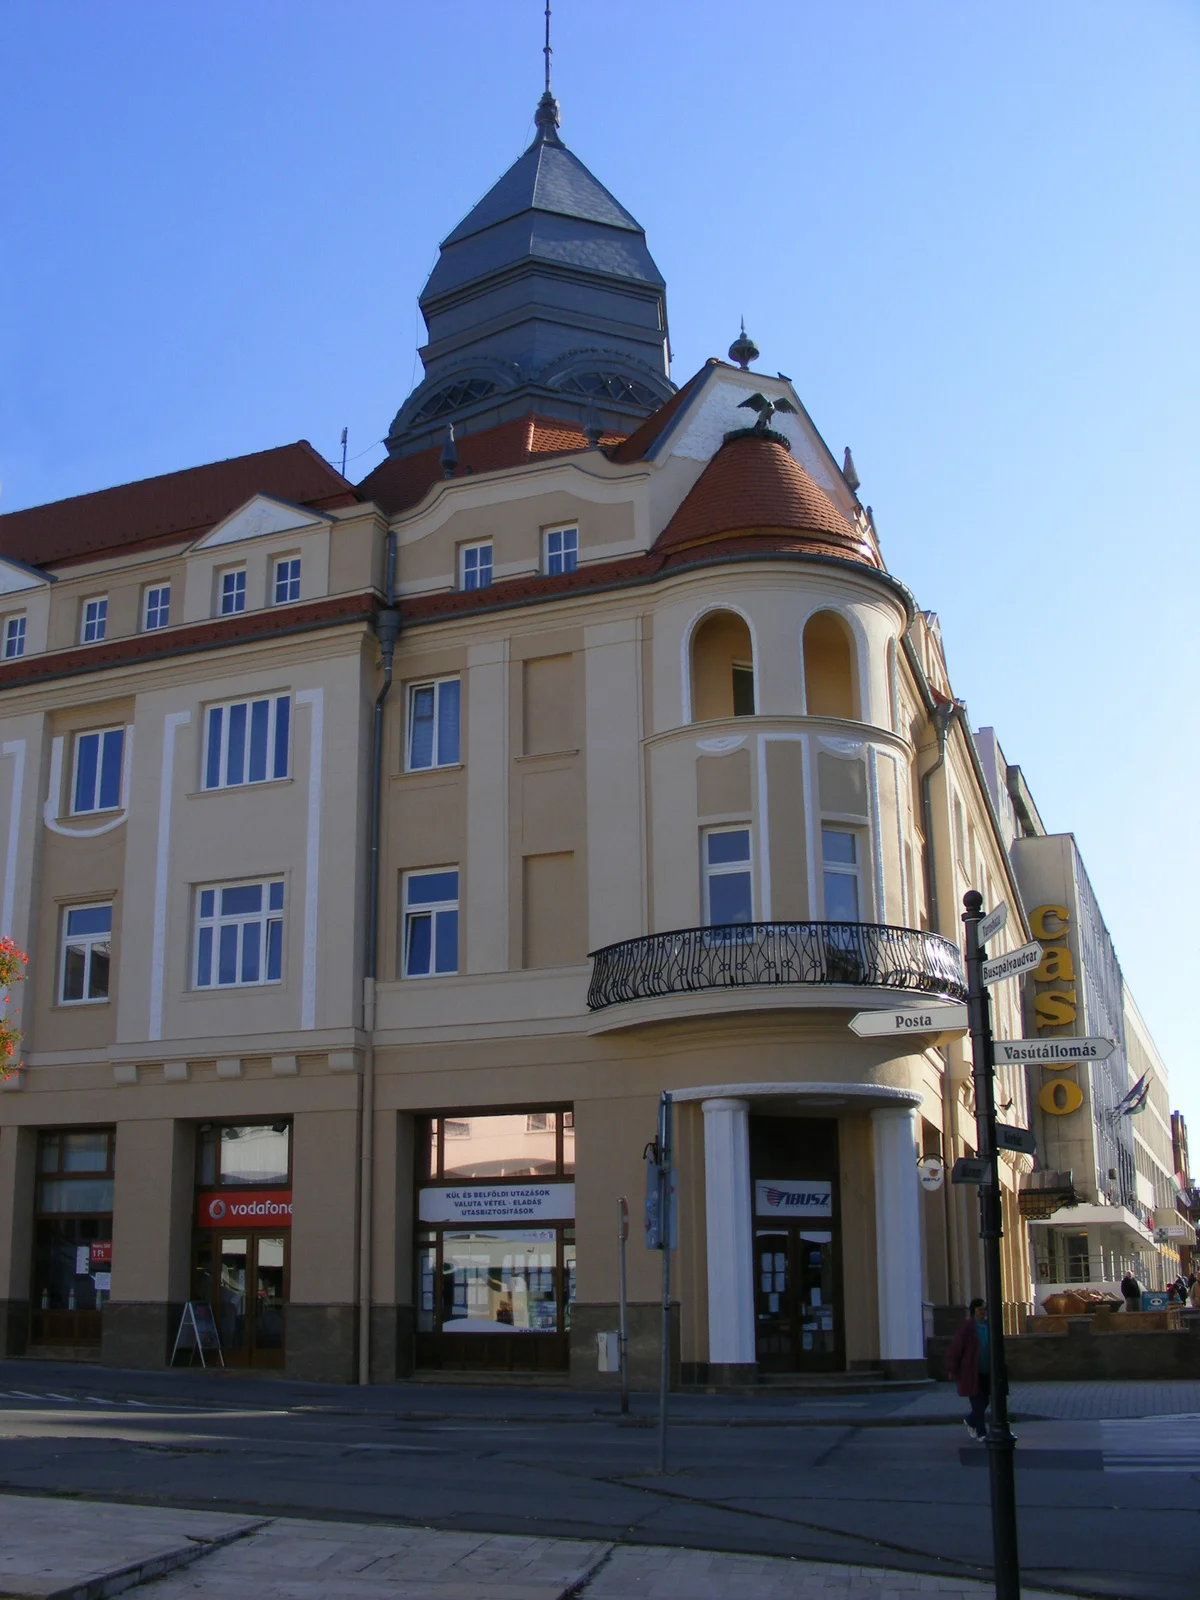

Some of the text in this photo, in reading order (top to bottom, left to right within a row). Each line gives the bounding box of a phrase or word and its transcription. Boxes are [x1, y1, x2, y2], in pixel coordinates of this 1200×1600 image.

[983, 950, 1037, 979] Buszpályaudvar
[895, 1015, 932, 1028] Posta
[1004, 1042, 1097, 1059] Vasútállomás
[463, 1190, 472, 1198] ÉS
[474, 1190, 508, 1198] BELFÖLDI
[511, 1189, 550, 1197] UTAZÁSOK
[785, 1192, 830, 1205] IBUSZ
[454, 1200, 482, 1208] VALUTA
[484, 1199, 506, 1207] VÉTEL
[513, 1198, 542, 1206] ELADÁS
[461, 1207, 534, 1216] UTASBIZTOSÍTÁSOK
